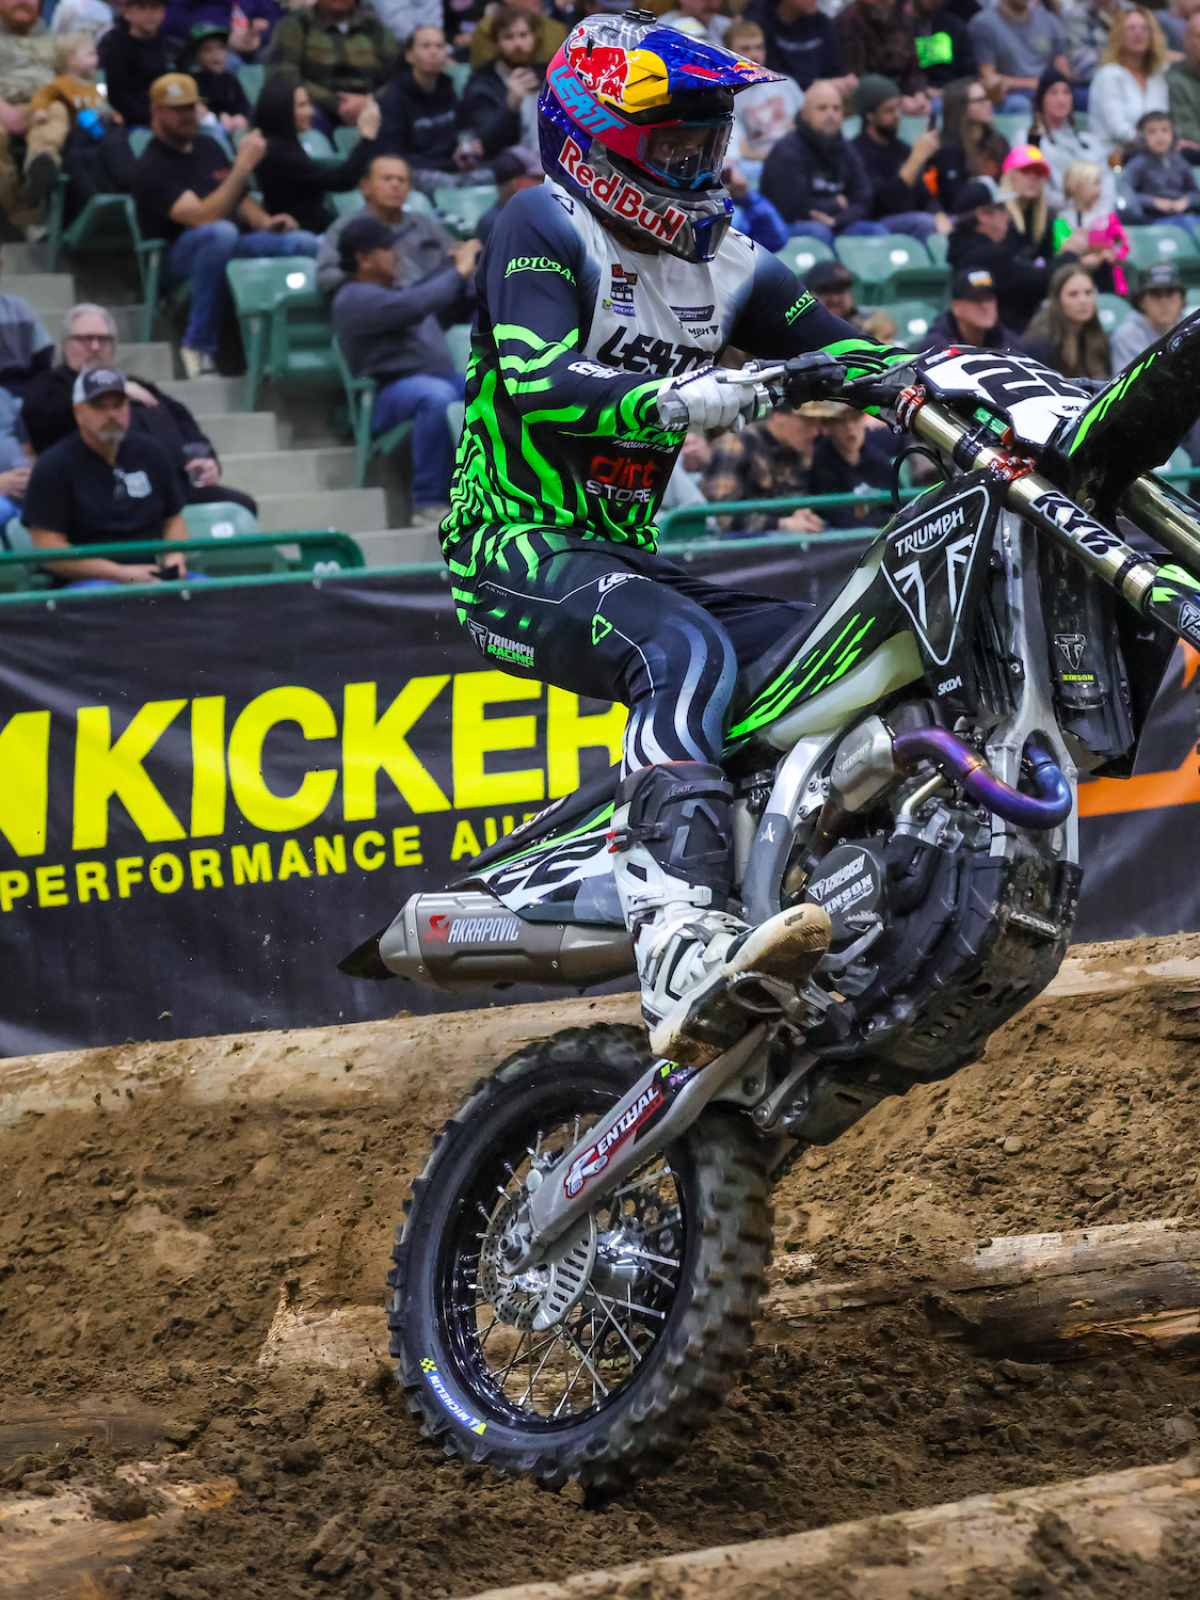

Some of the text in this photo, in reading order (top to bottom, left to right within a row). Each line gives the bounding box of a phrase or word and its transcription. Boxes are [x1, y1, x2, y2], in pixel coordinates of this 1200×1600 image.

[550, 64, 627, 134] LEATT
[558, 136, 622, 206] Red
[619, 427, 688, 447] ACING
[585, 479, 652, 503] STORE
[895, 507, 965, 557] TRIUMPH
[487, 643, 535, 667] RACING
[488, 632, 535, 657] TRIUMPH
[1, 826, 422, 911] PERFORMANCE
[820, 873, 874, 915] INSON
[565, 1087, 661, 1196] RENTHAL
[428, 1374, 471, 1426] MICHELIN
